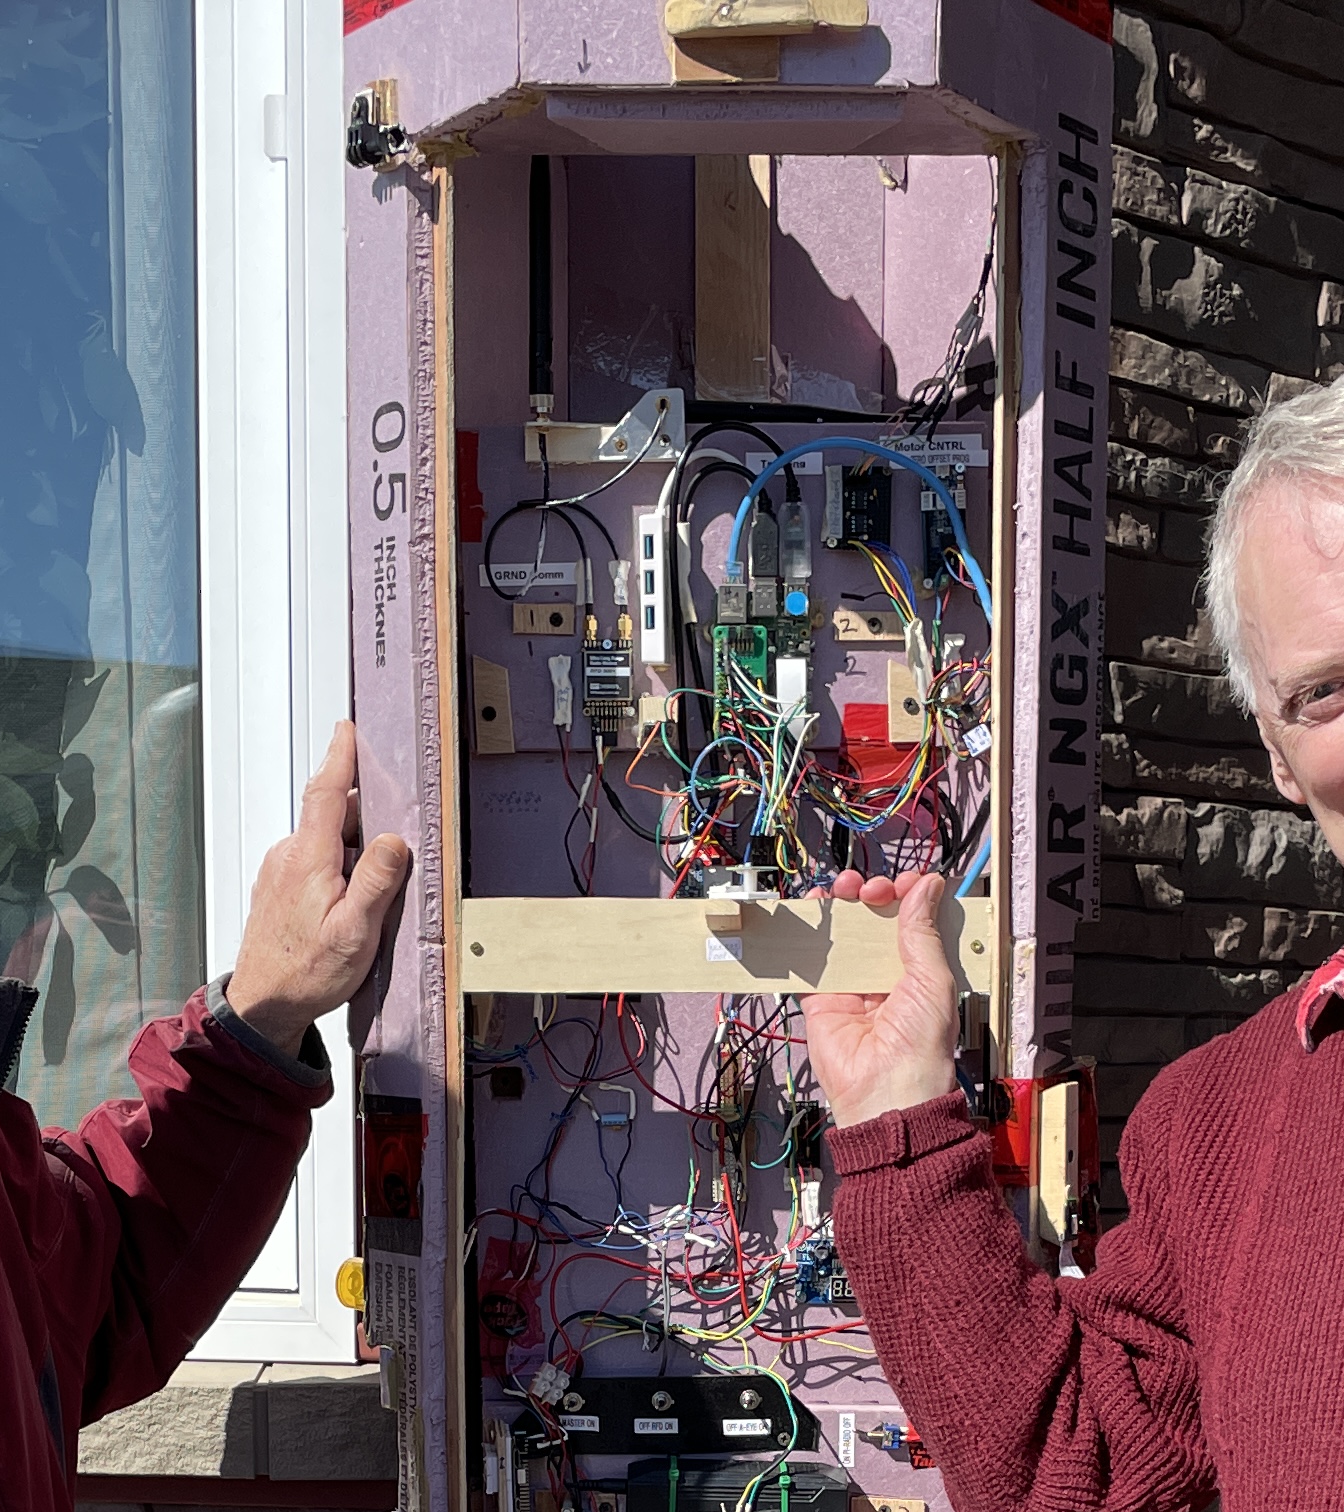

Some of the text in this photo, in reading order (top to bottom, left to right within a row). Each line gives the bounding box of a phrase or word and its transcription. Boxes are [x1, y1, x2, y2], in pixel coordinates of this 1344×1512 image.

[1056, 110, 1099, 329] INCH
[895, 441, 966, 452] Motor CNTRL
[1053, 349, 1095, 557] HALF
[371, 401, 406, 602] 0.5 INCH
[494, 570, 564, 581] GRND omm
[408, 1334, 417, 1351] DE
[638, 1421, 650, 1431] OFF
[911, 1455, 936, 1468] Tap
